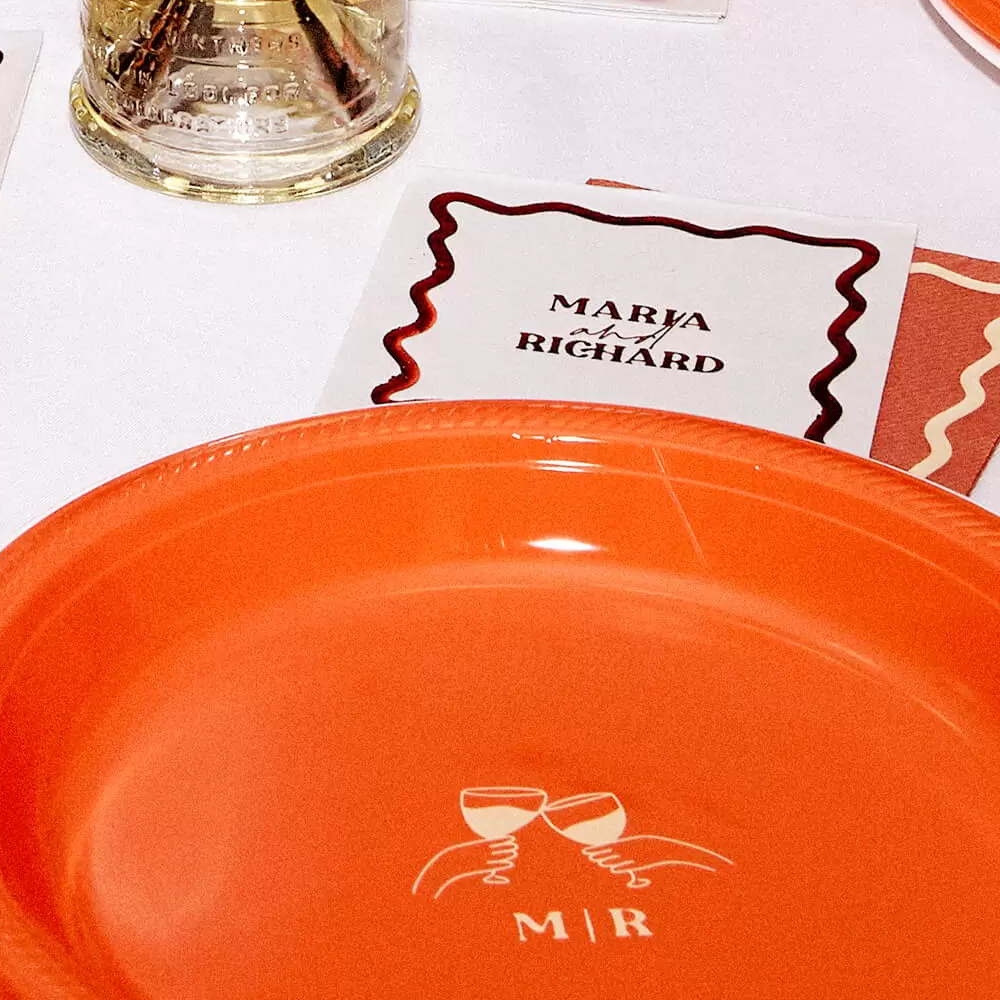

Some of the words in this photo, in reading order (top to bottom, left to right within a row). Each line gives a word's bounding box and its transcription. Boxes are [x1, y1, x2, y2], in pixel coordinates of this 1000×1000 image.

[548, 293, 712, 332] MARIA
[569, 312, 687, 350] and
[515, 331, 725, 374] RICHARD
